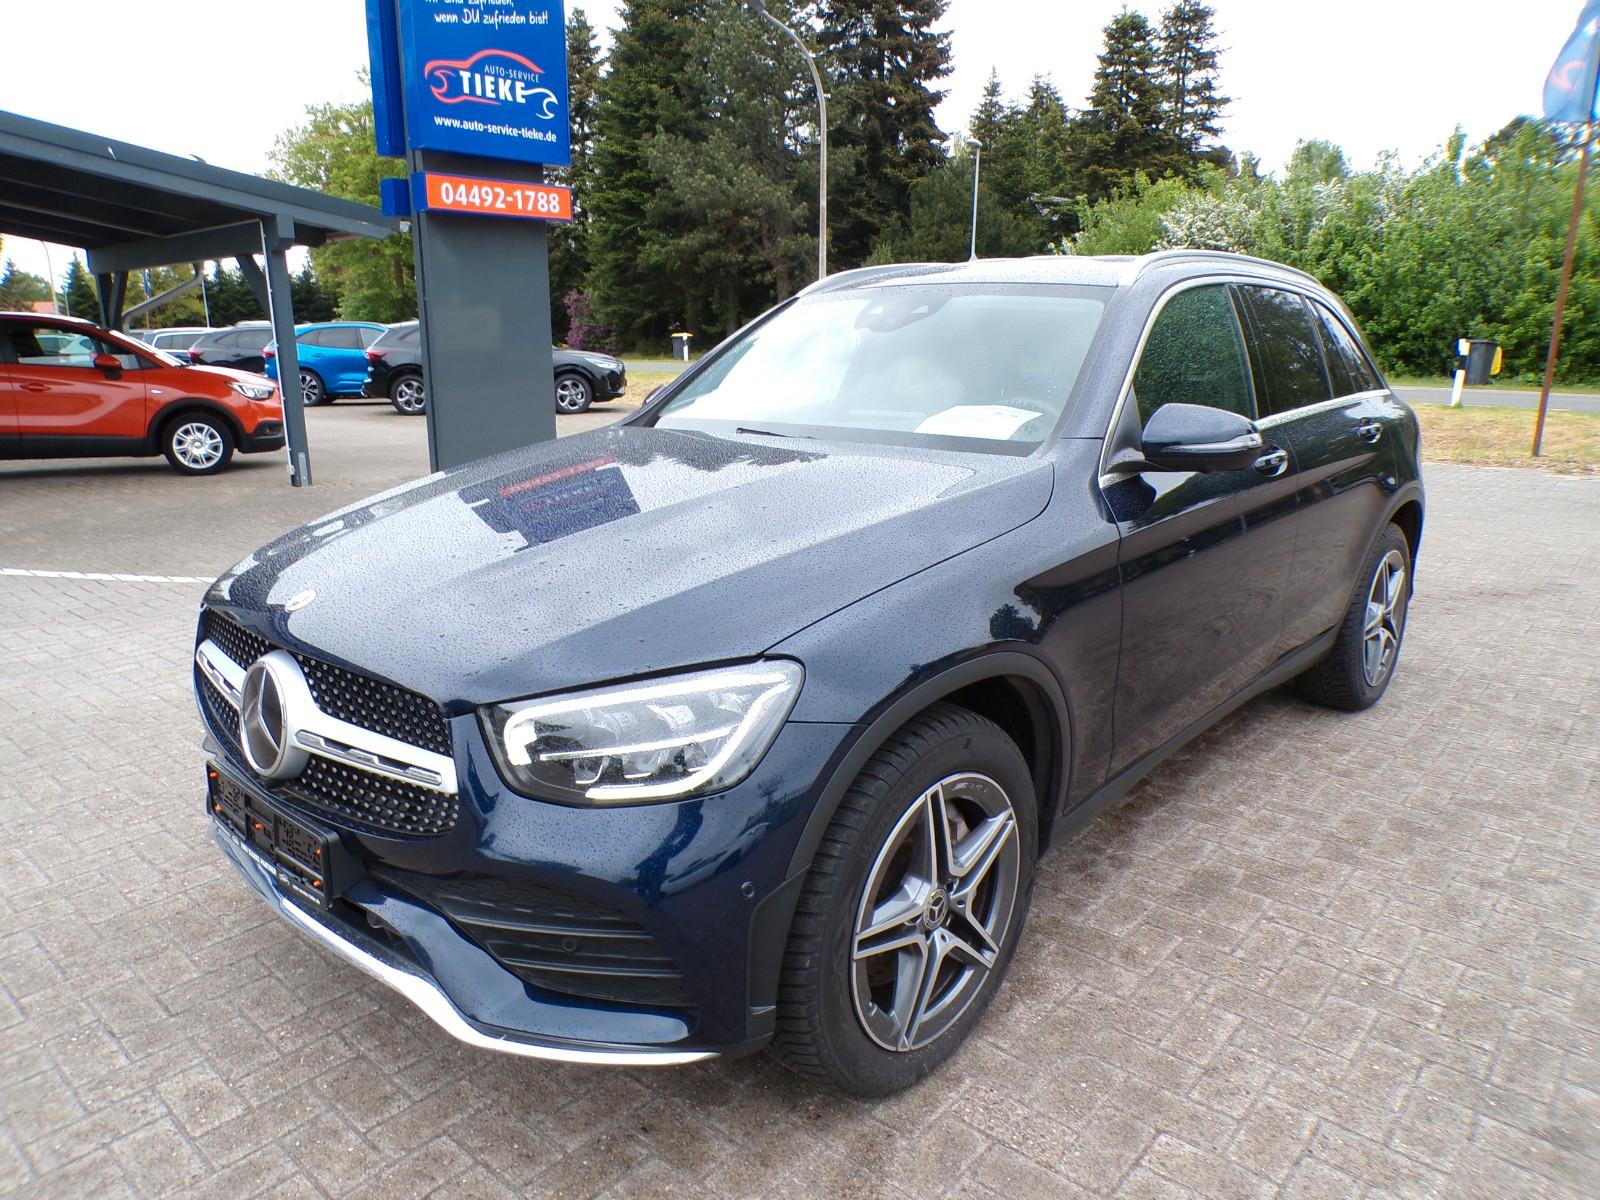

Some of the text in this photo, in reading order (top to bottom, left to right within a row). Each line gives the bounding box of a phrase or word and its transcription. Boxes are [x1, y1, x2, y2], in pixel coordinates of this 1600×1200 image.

[434, 8, 549, 30] wenn DU zufrieden bist!
[459, 71, 527, 104] TIEKE
[484, 64, 540, 84] AUTO-SERVICE
[434, 116, 557, 143] www.auto-service-tieke.de
[441, 182, 560, 213] 04492-1788
